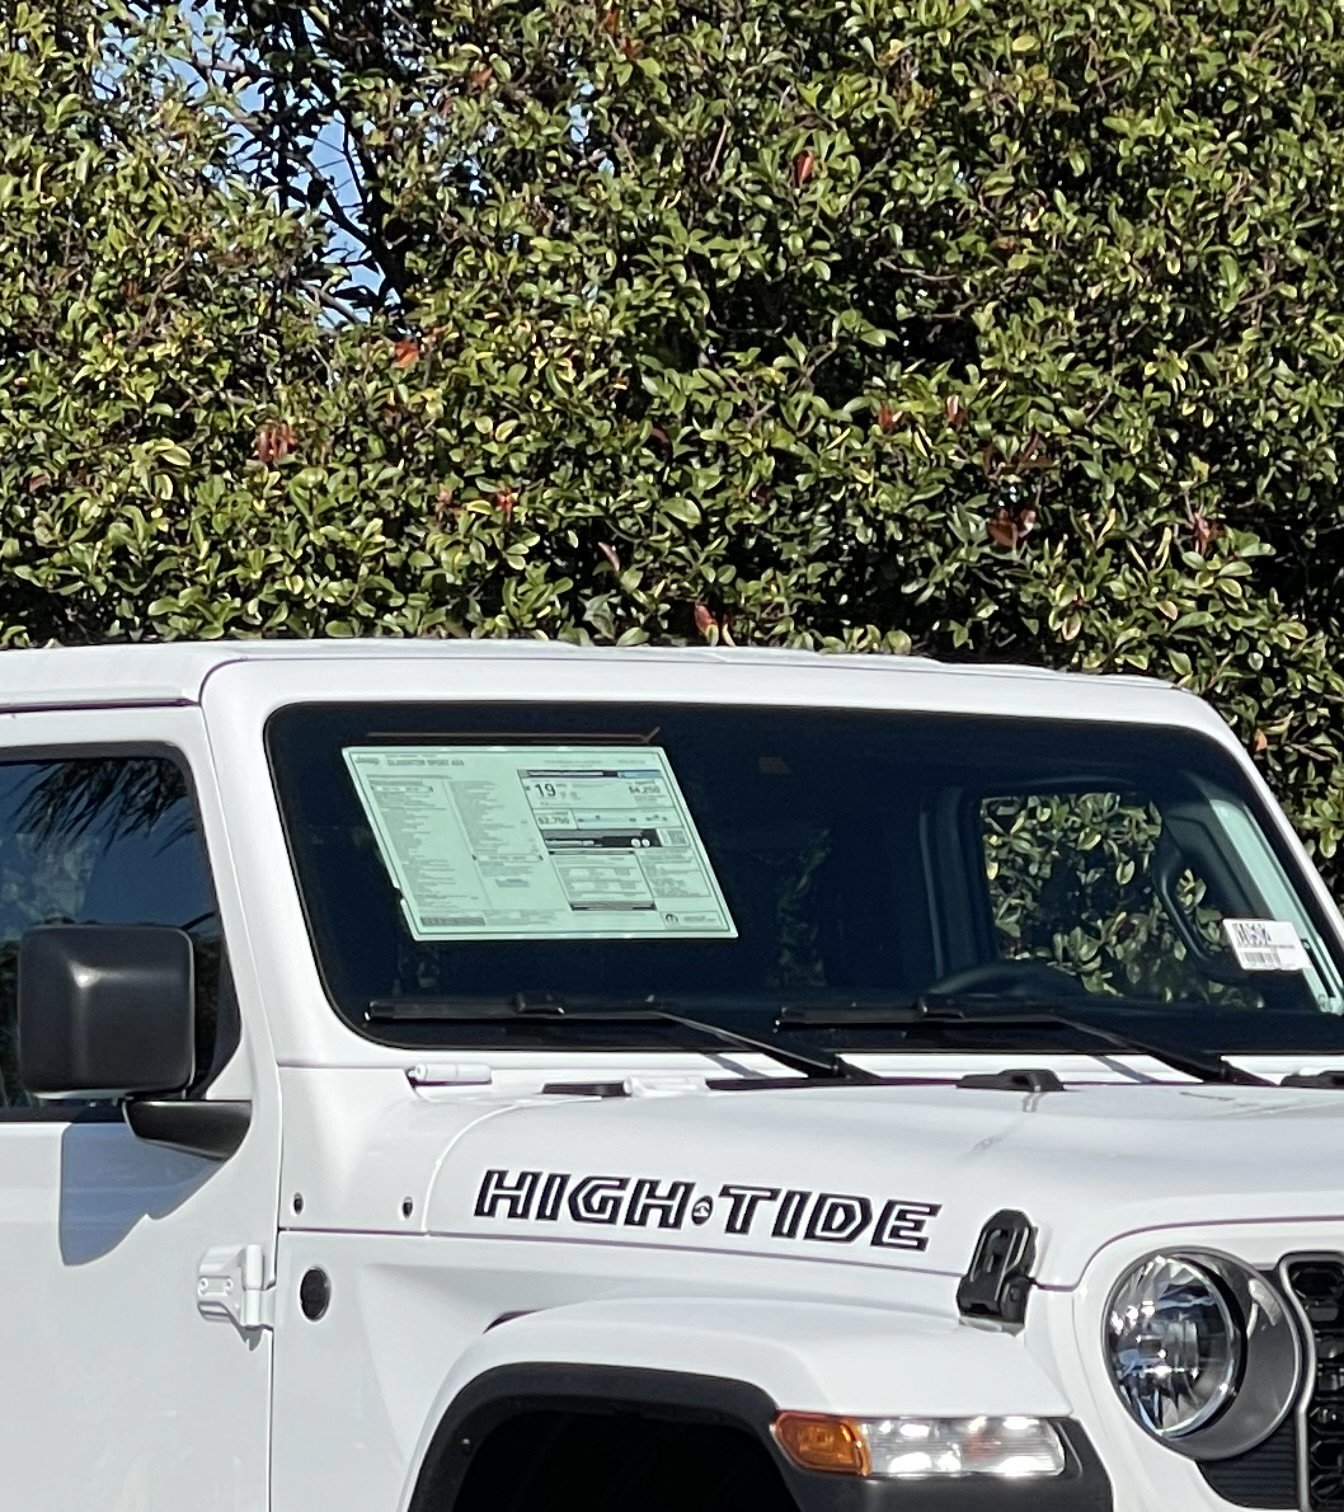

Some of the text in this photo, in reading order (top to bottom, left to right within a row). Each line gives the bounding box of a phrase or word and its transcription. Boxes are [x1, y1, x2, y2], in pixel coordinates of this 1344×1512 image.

[535, 783, 556, 798] 19
[473, 1168, 943, 1253] HIGH TIDE
